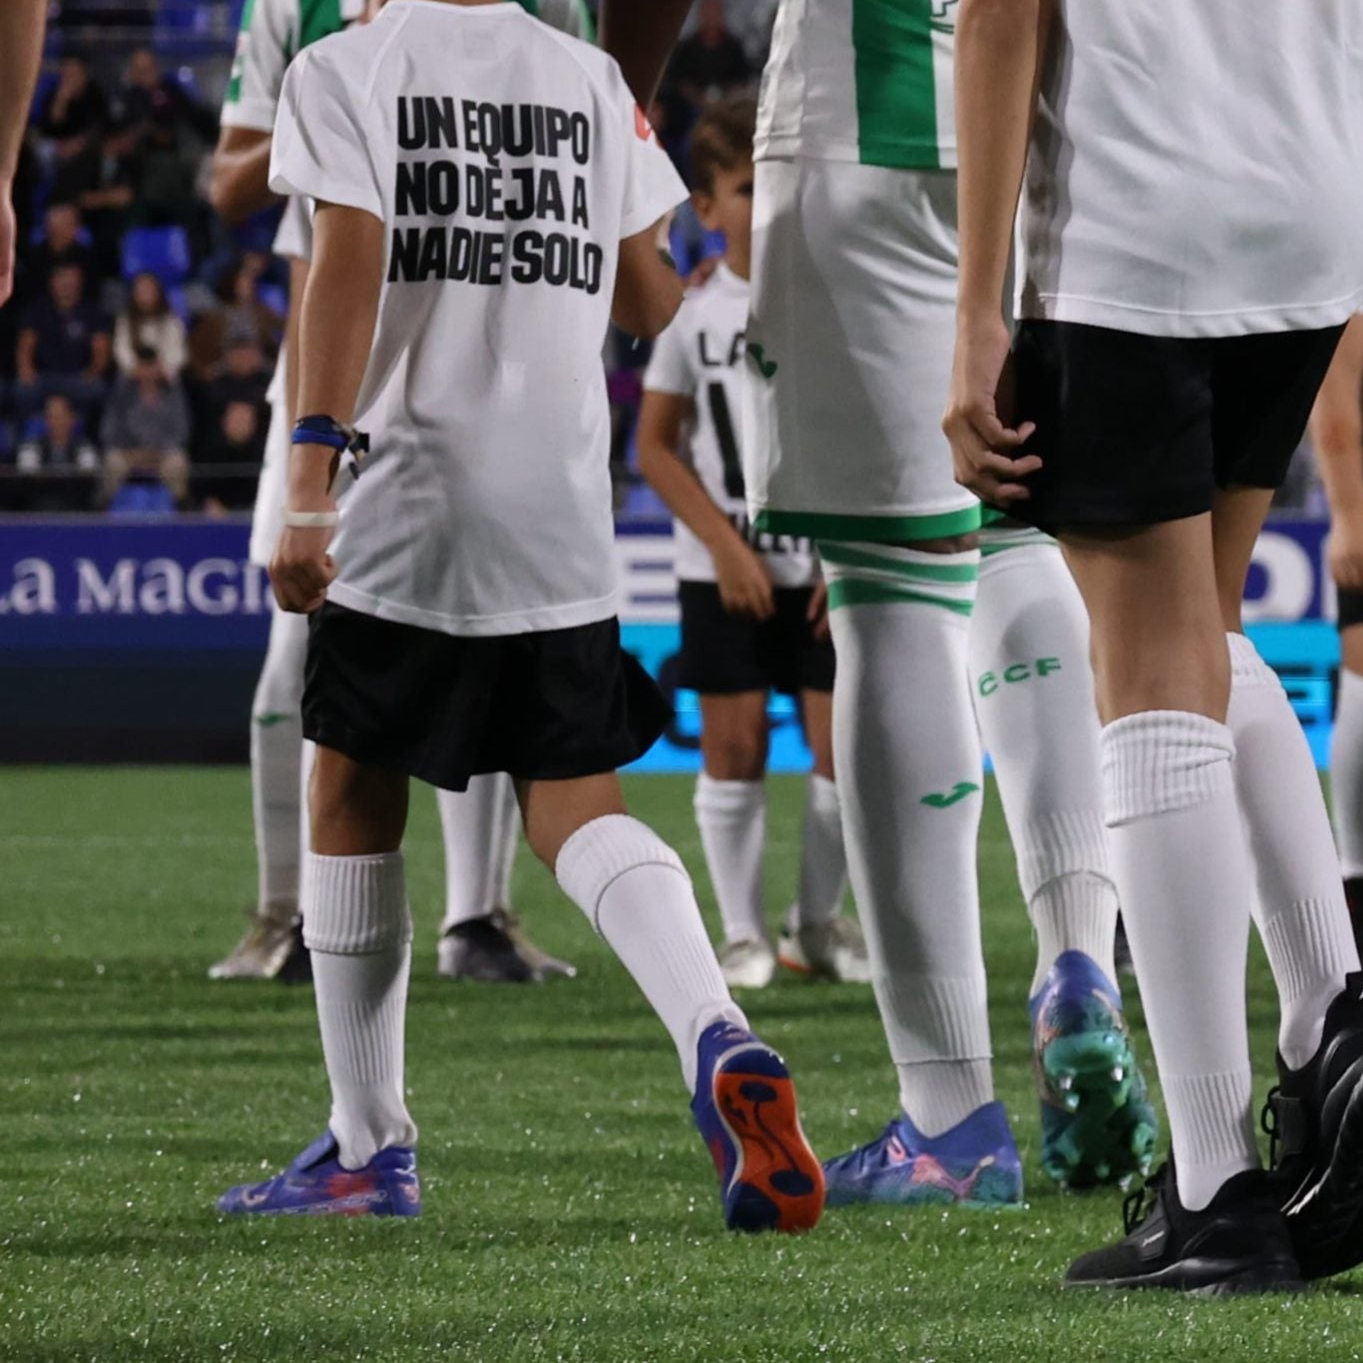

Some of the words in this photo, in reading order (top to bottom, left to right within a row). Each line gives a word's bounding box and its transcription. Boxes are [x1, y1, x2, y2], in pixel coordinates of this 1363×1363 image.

[397, 96, 458, 150] UN
[461, 99, 589, 167] EQUIPO
[395, 160, 459, 216] NO
[466, 163, 566, 221] DEJA
[572, 175, 589, 230] A
[387, 227, 505, 285] NADIE
[511, 230, 603, 295] SOLO
[978, 657, 1062, 696] CCF
